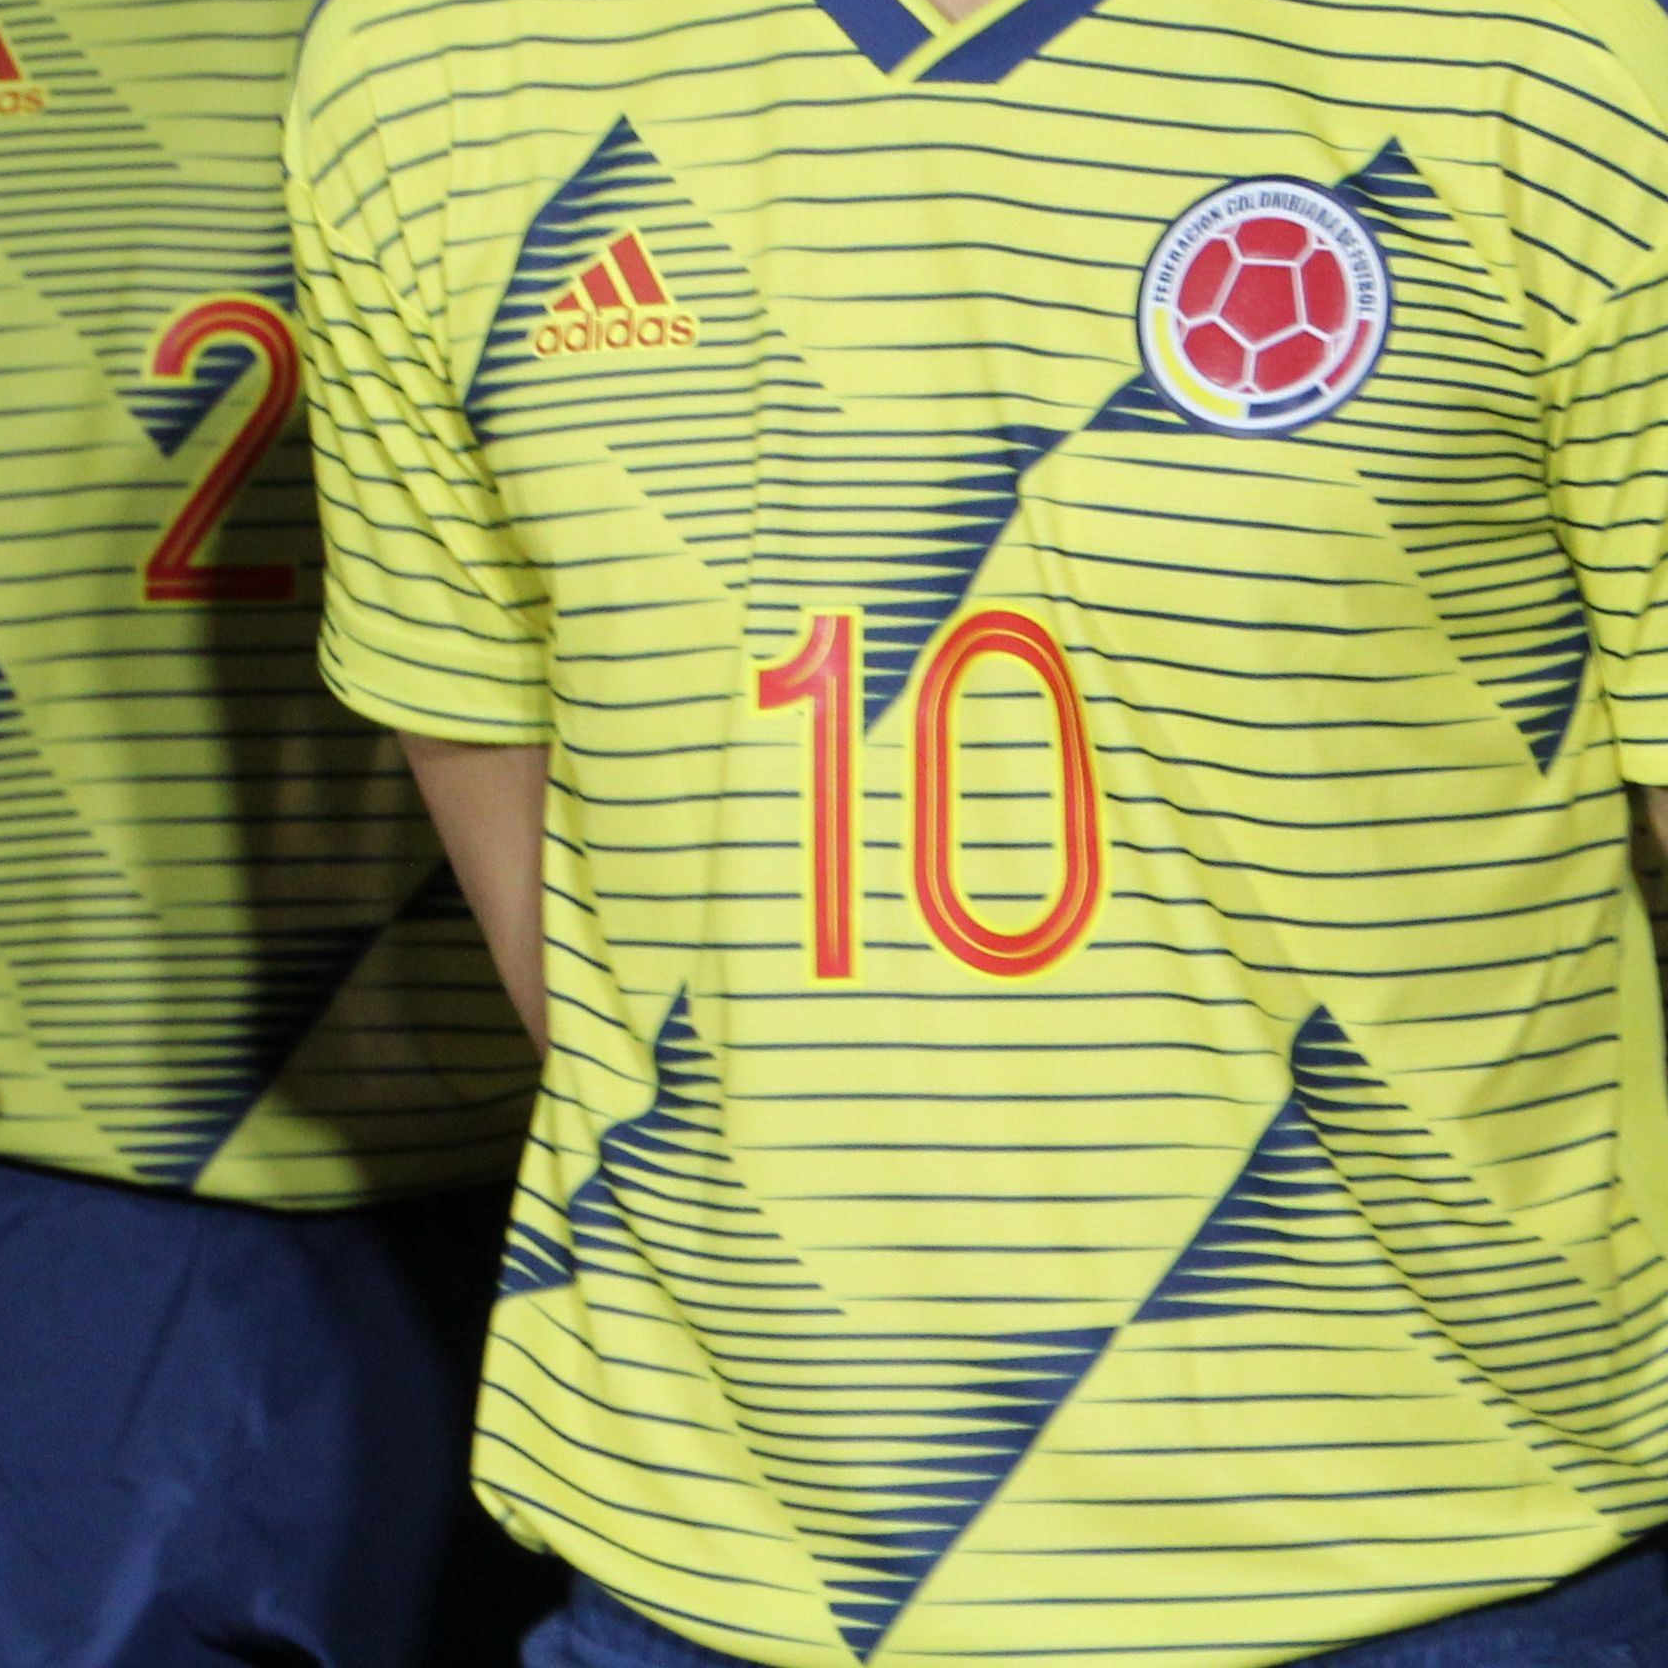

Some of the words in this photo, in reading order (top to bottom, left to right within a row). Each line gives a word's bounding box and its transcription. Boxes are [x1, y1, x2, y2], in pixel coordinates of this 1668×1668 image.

[143, 297, 302, 602] 2
[533, 308, 697, 357] adidas
[756, 607, 1106, 981] 10
